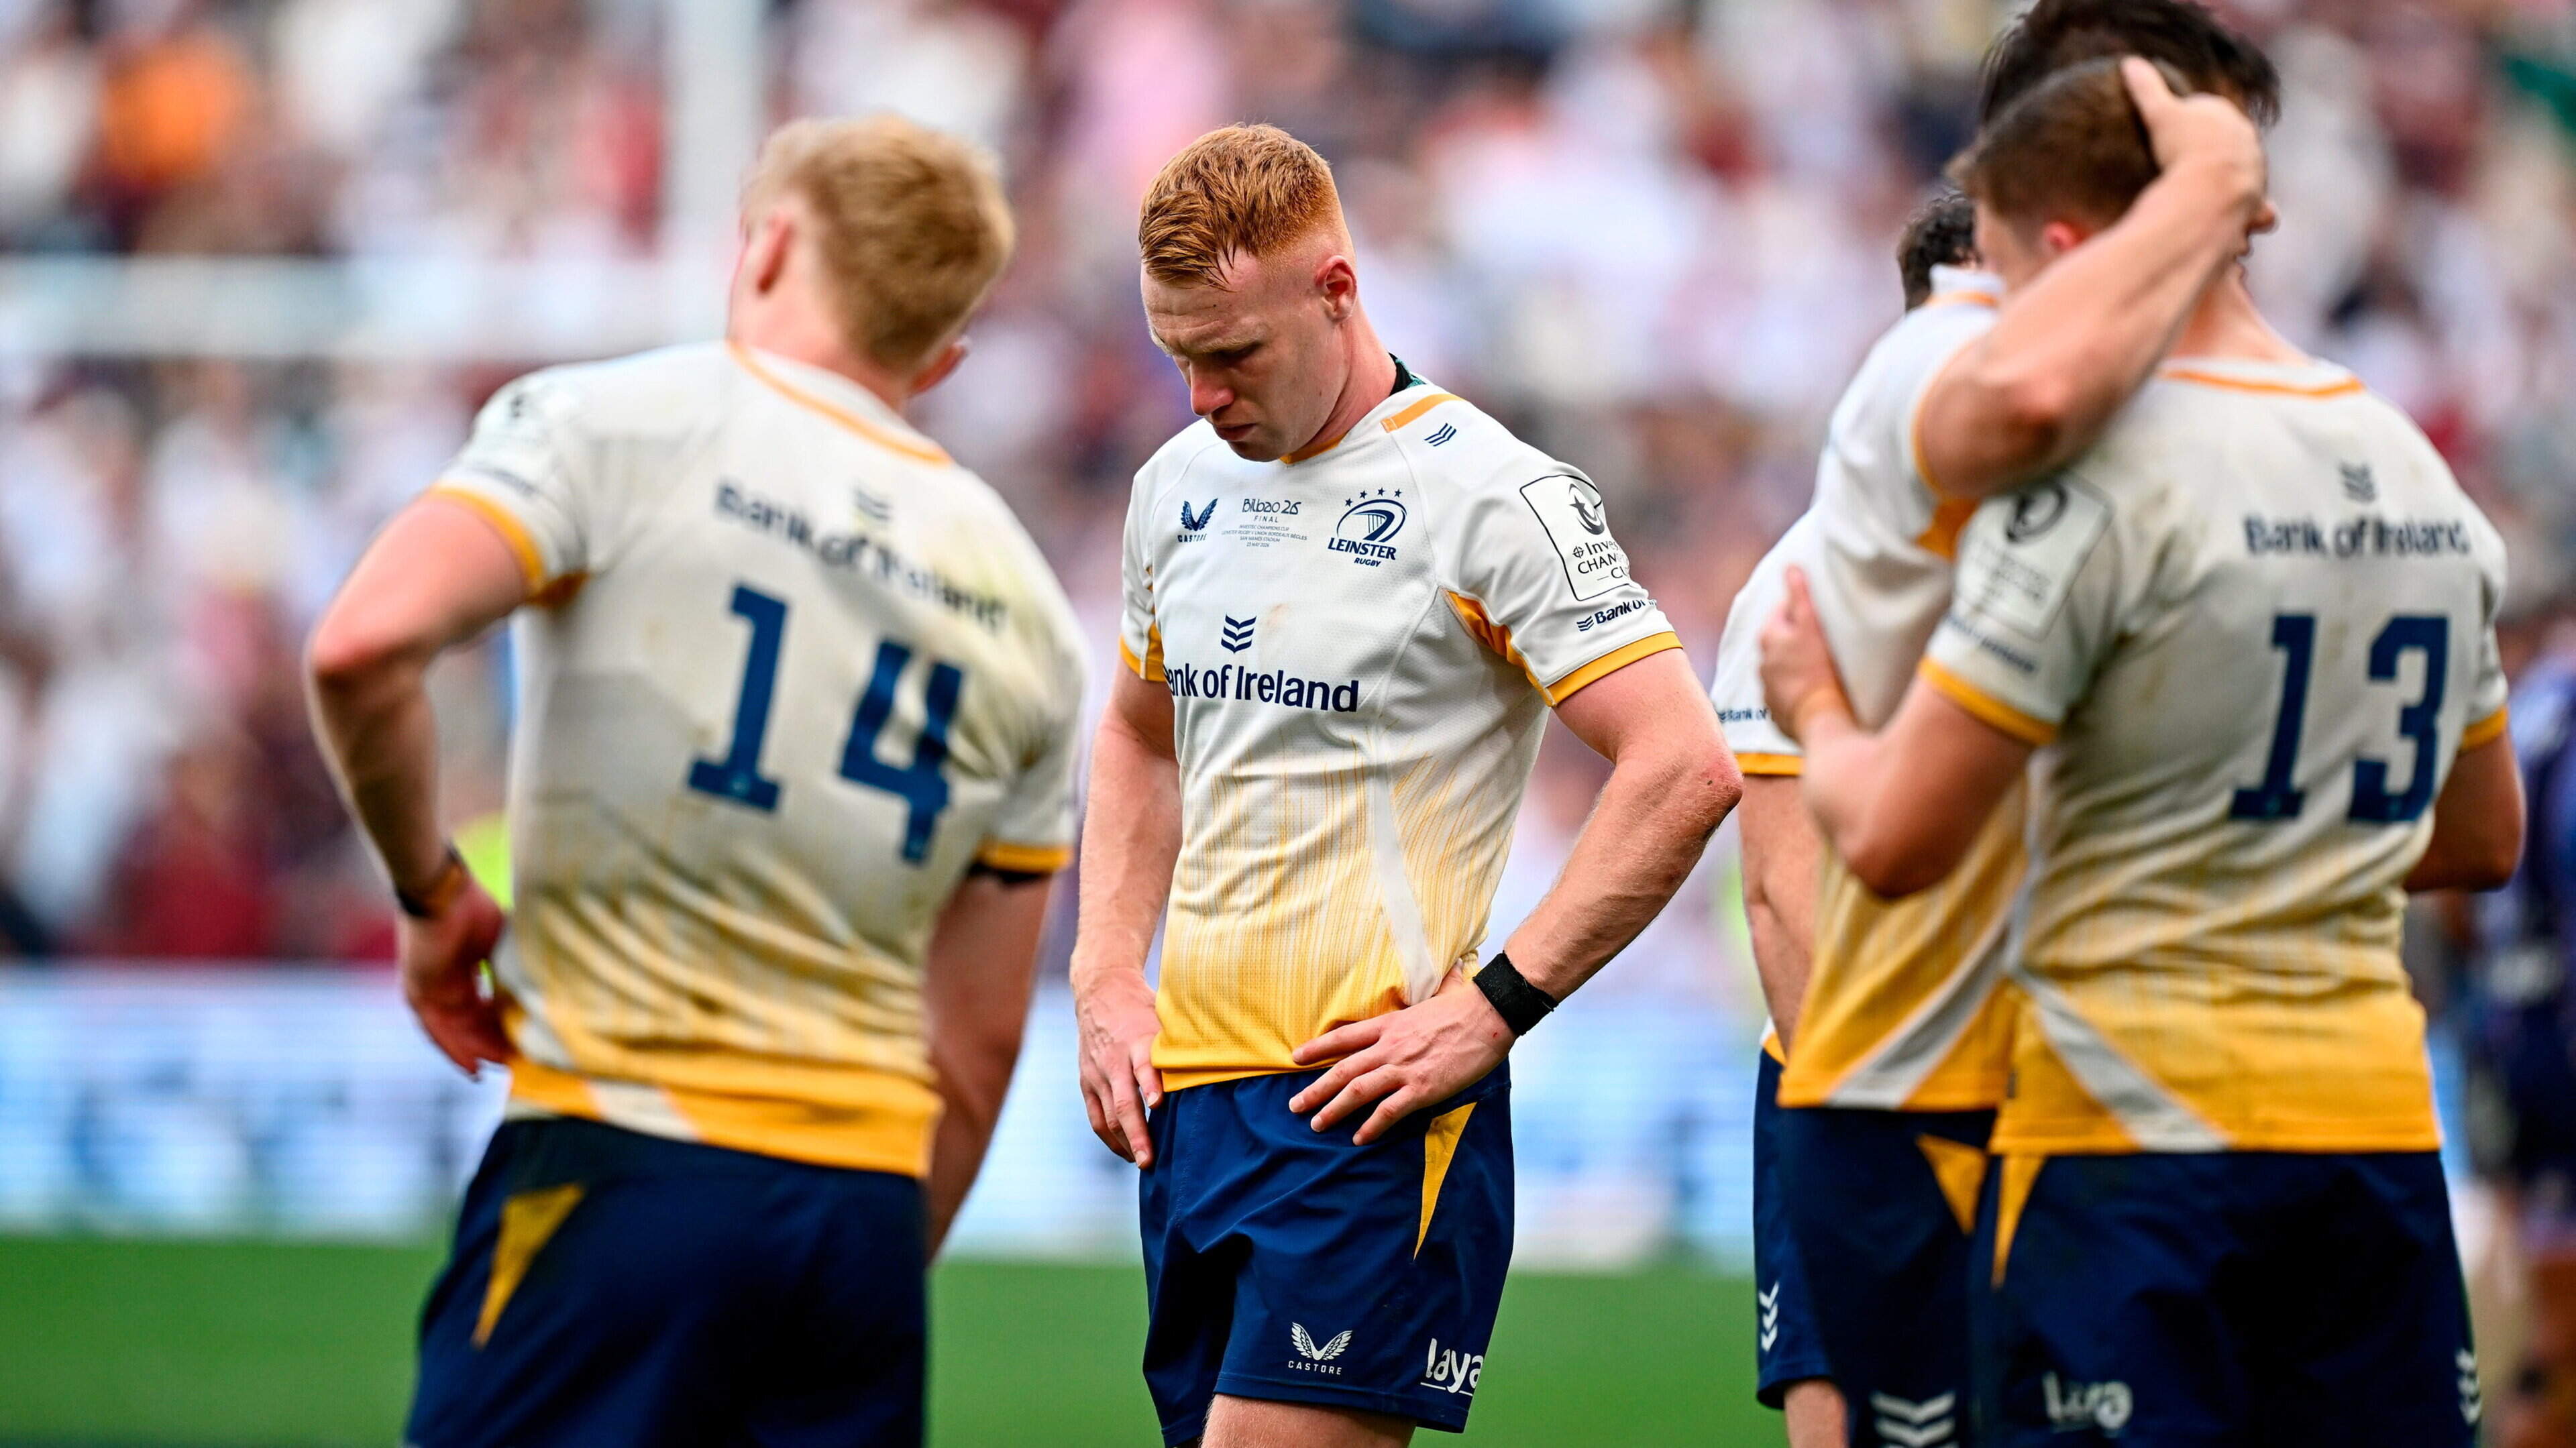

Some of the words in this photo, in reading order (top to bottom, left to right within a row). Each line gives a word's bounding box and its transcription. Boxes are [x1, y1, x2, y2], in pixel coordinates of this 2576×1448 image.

[1242, 498, 1280, 513] Bilbao
[1281, 500, 1301, 515] 26
[1253, 515, 1279, 523] FINAL
[2243, 514, 2328, 557] Bank
[1328, 537, 1397, 561] LEINSTER
[1585, 541, 1619, 555] Inves
[1354, 557, 1381, 567] RUGBY
[1594, 602, 1632, 624] Bank
[1163, 663, 1199, 697] ank
[1203, 665, 1232, 698] of
[1235, 665, 1359, 713] Ireland
[687, 581, 966, 867] 14
[2229, 613, 2451, 824] 13
[1288, 1360, 1342, 1376] CASTORE
[1426, 1338, 1485, 1394] laya
